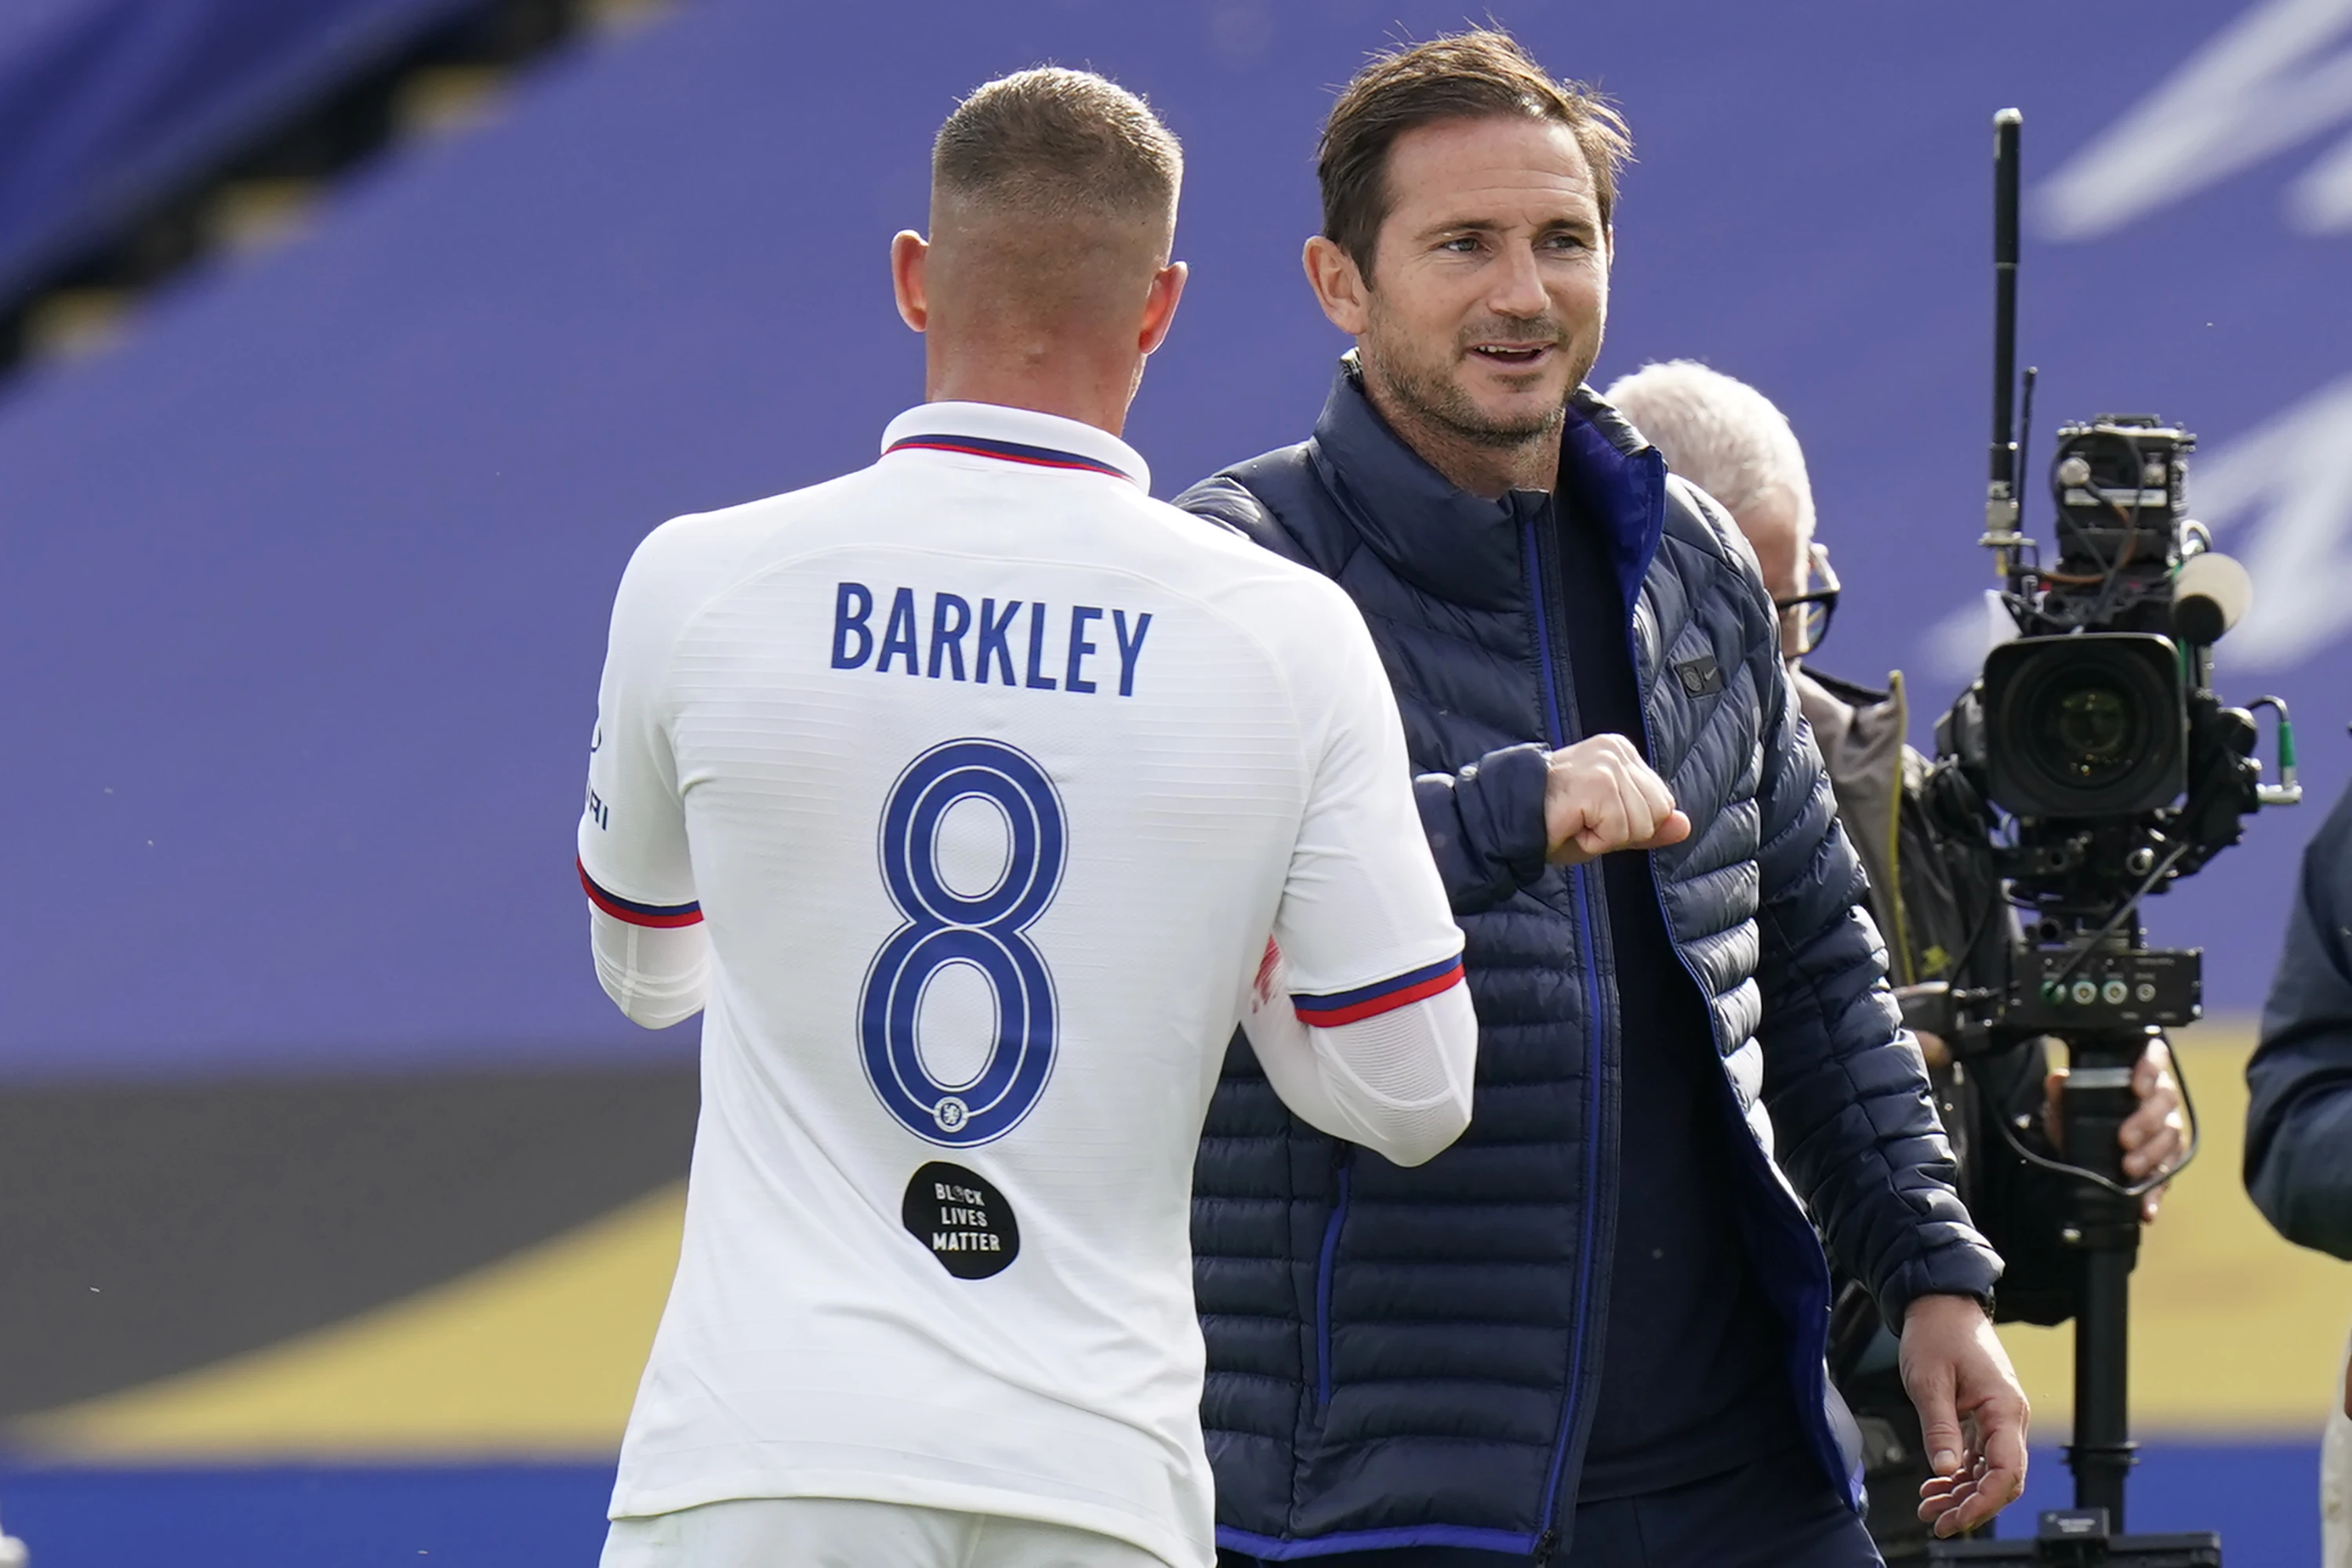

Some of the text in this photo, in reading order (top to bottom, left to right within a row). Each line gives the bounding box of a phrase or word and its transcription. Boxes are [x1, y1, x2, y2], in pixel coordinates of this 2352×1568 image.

[831, 582, 1152, 696] BARKLEY
[856, 737, 1069, 1149] 8
[932, 1232, 1000, 1251] MATTER
[941, 1207, 988, 1227] LIVES
